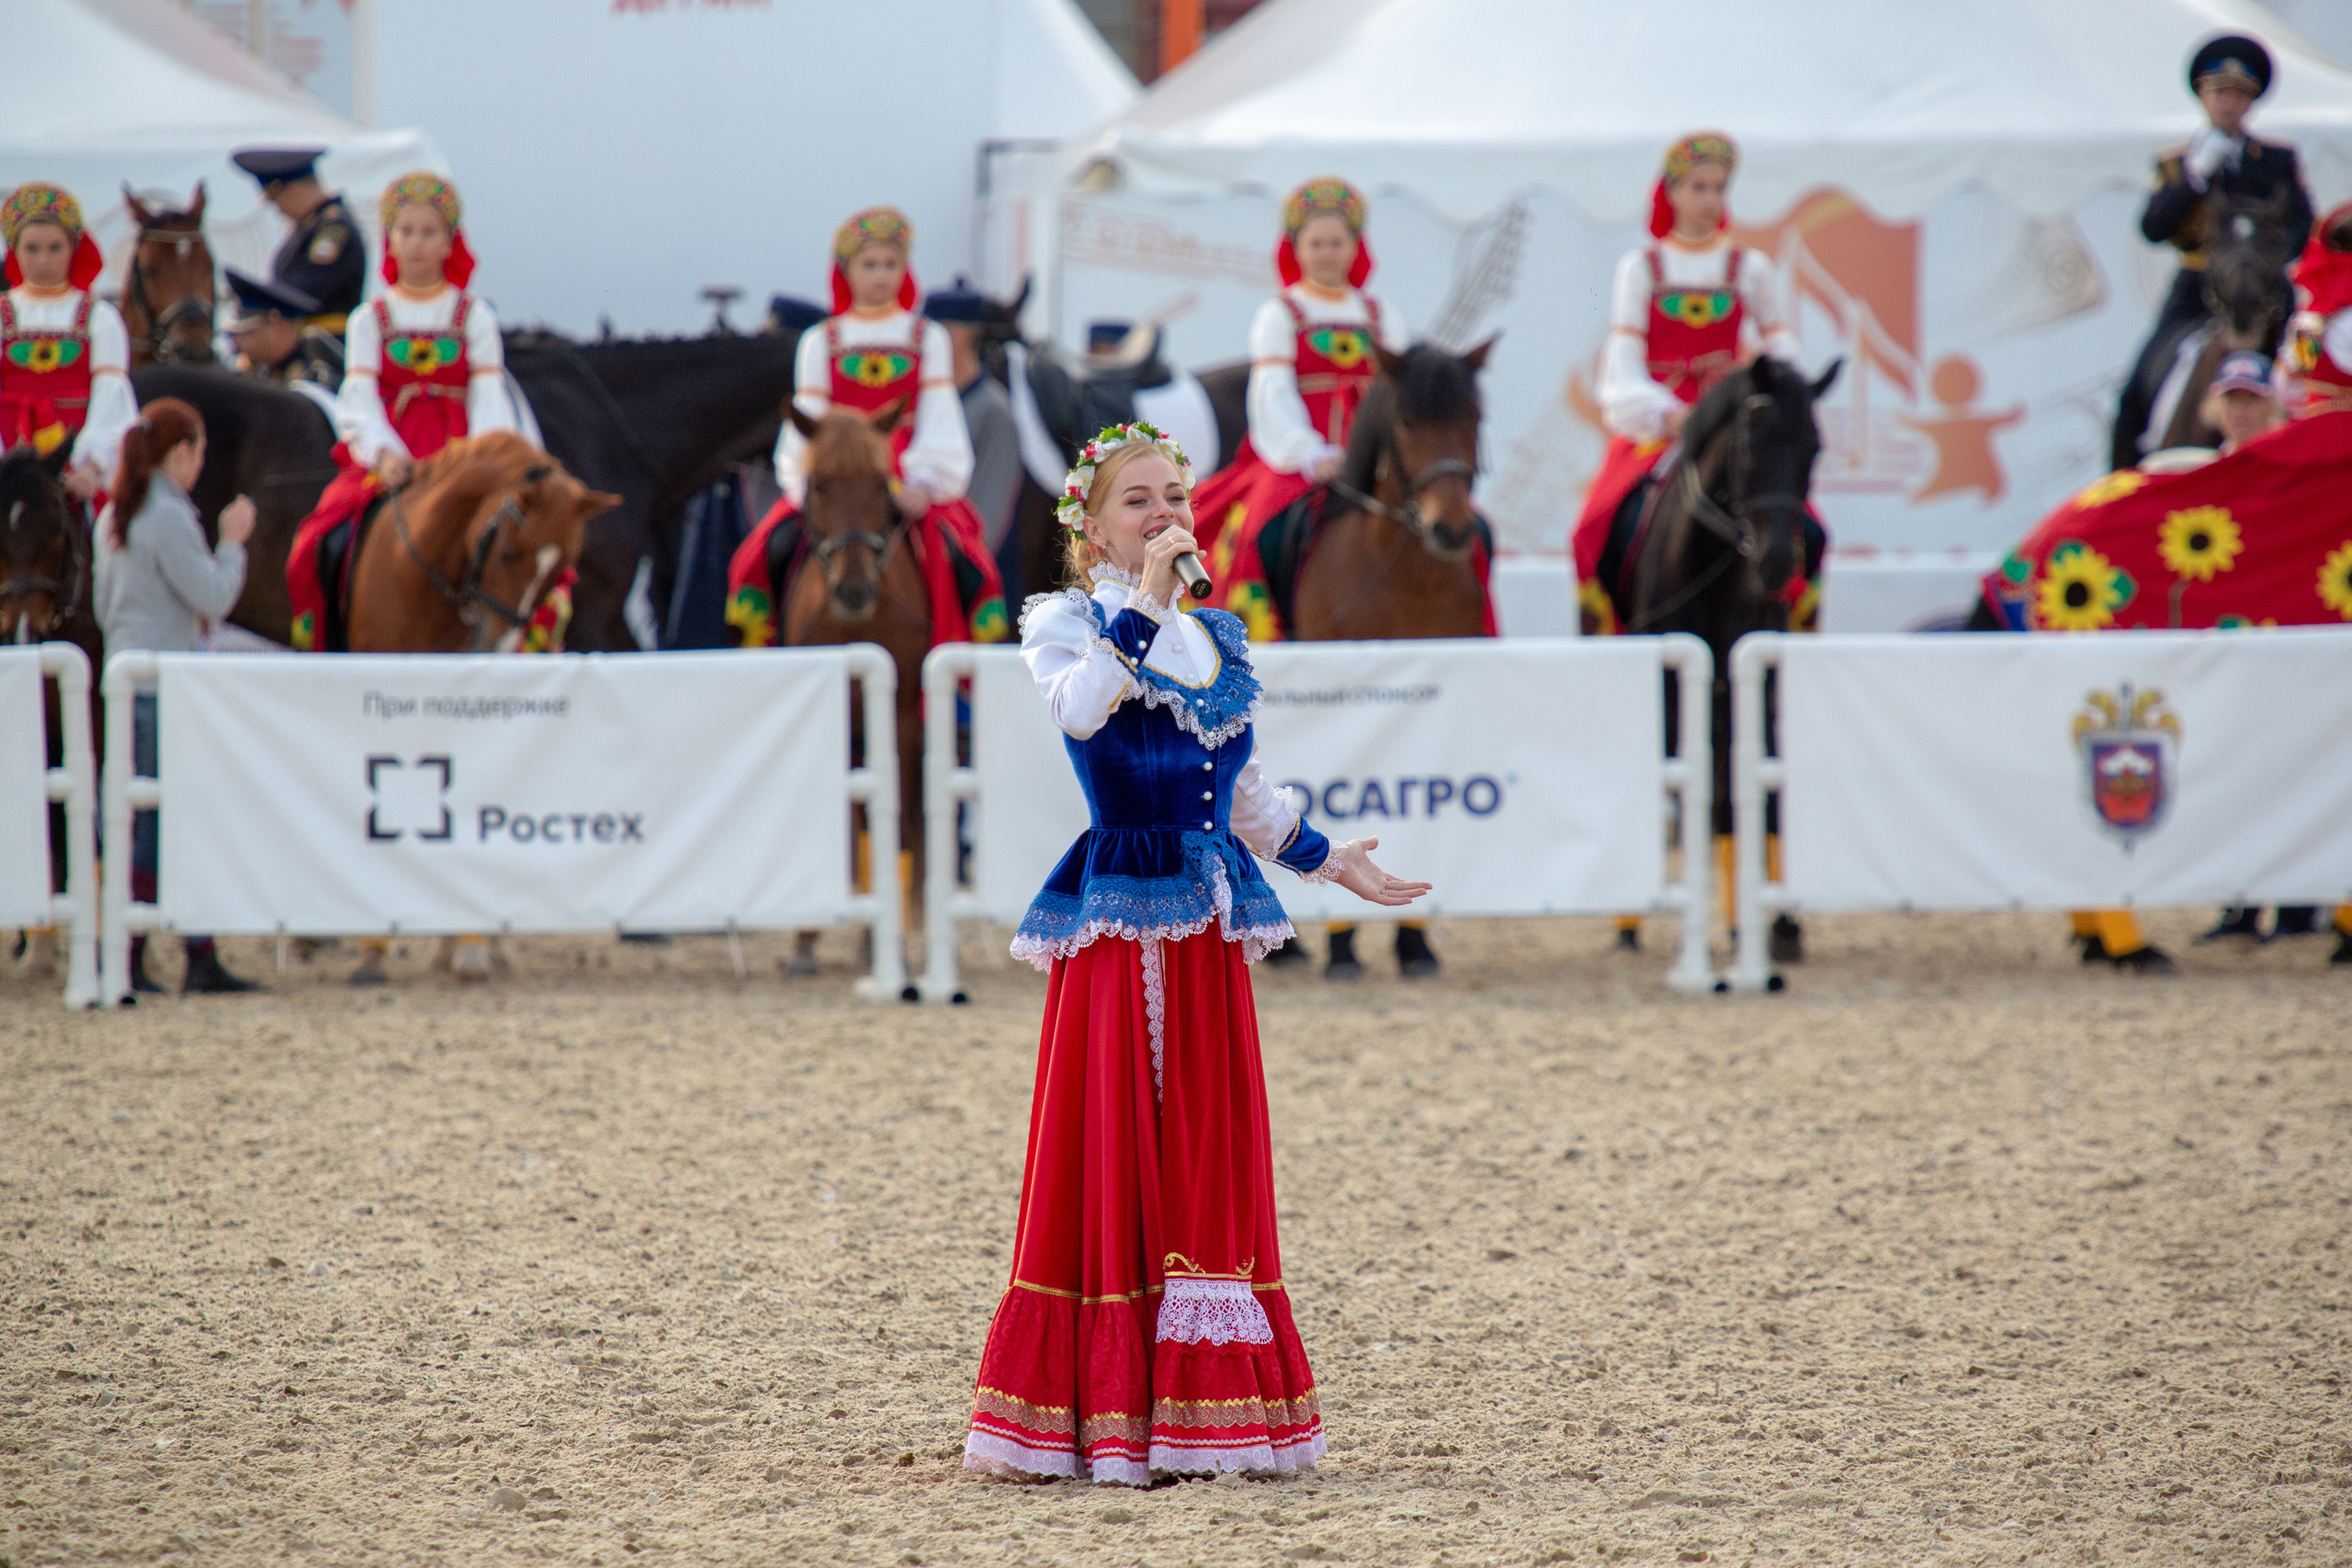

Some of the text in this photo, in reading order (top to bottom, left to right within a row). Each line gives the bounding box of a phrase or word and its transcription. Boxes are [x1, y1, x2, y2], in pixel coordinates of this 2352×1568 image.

[363, 690, 571, 723] При поддержке
[1278, 773, 1503, 820] ОСАГРО
[478, 804, 644, 843] Ростех
